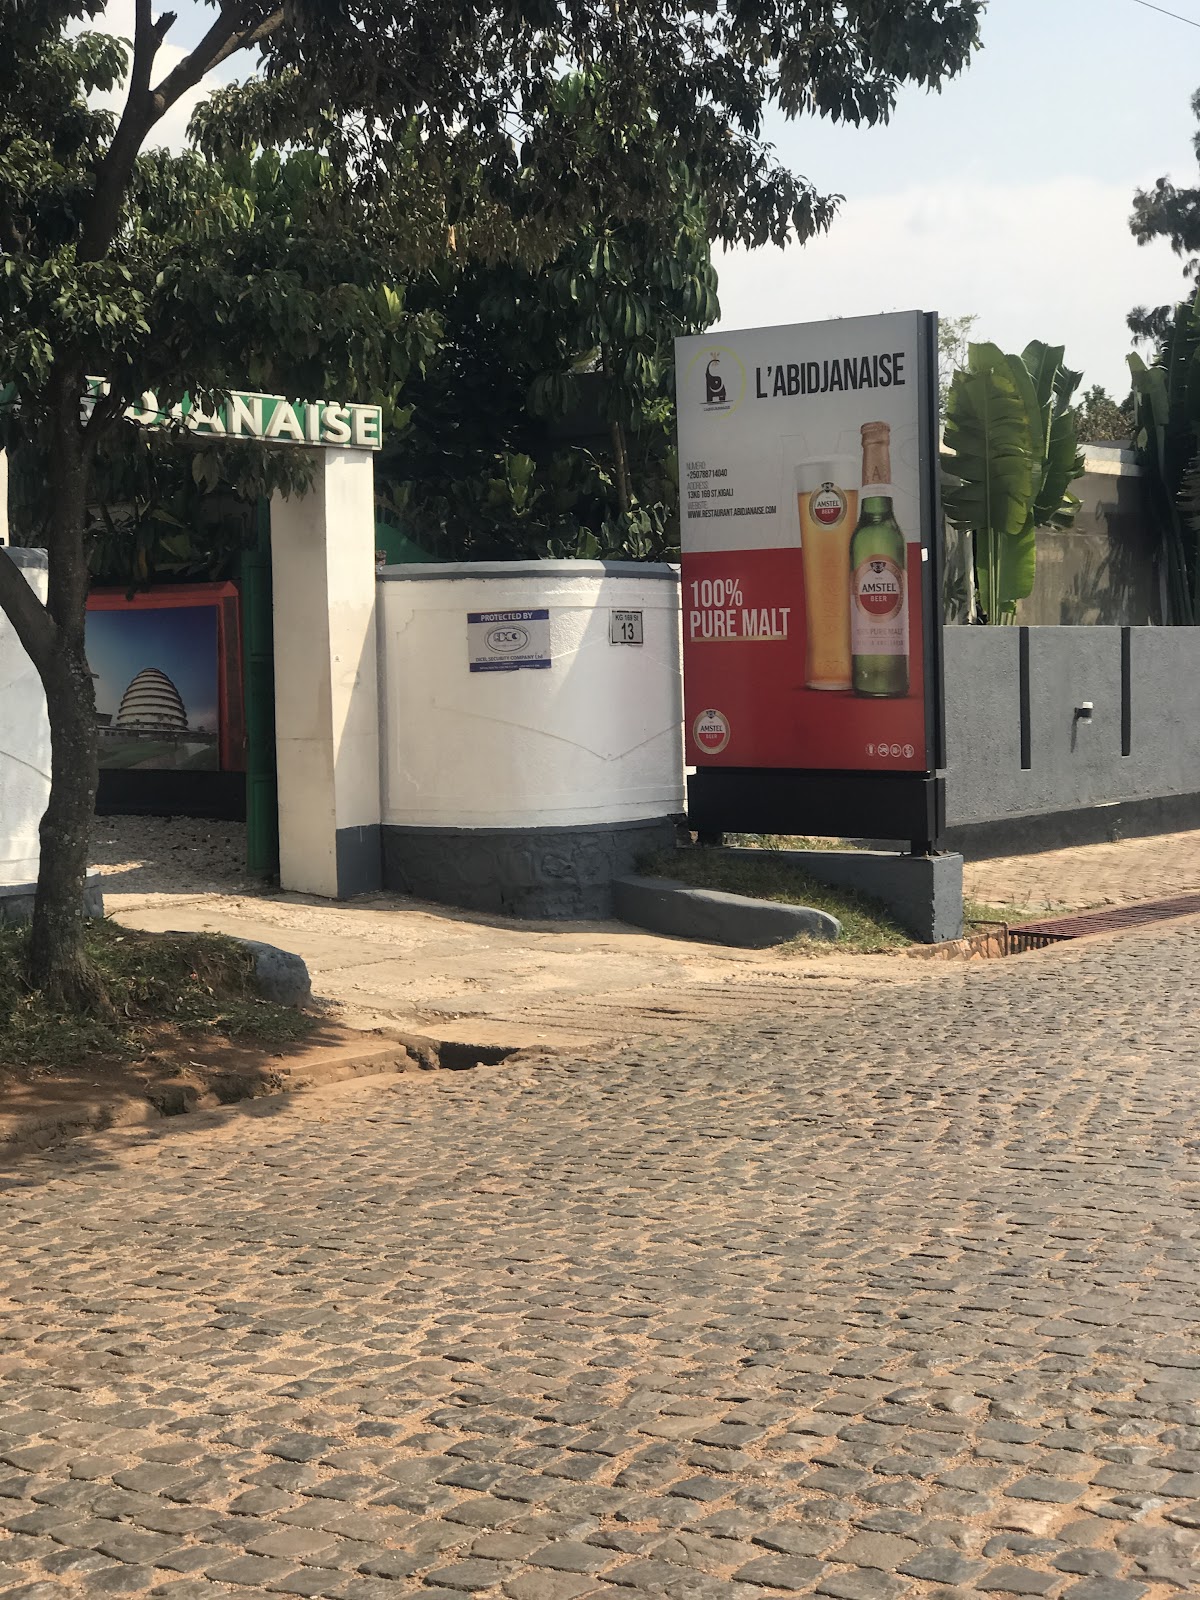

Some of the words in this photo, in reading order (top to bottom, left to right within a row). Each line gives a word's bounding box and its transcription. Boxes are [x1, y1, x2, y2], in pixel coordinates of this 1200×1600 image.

[756, 352, 906, 399] L'ABIDJANAISE
[690, 578, 743, 608] 100%
[862, 583, 897, 592] AMSTEL
[480, 612, 522, 622] PROTECTED
[690, 609, 737, 638] PURE
[742, 607, 791, 637] MALT
[621, 622, 635, 640] 13
[700, 724, 723, 732] AMSTEL
